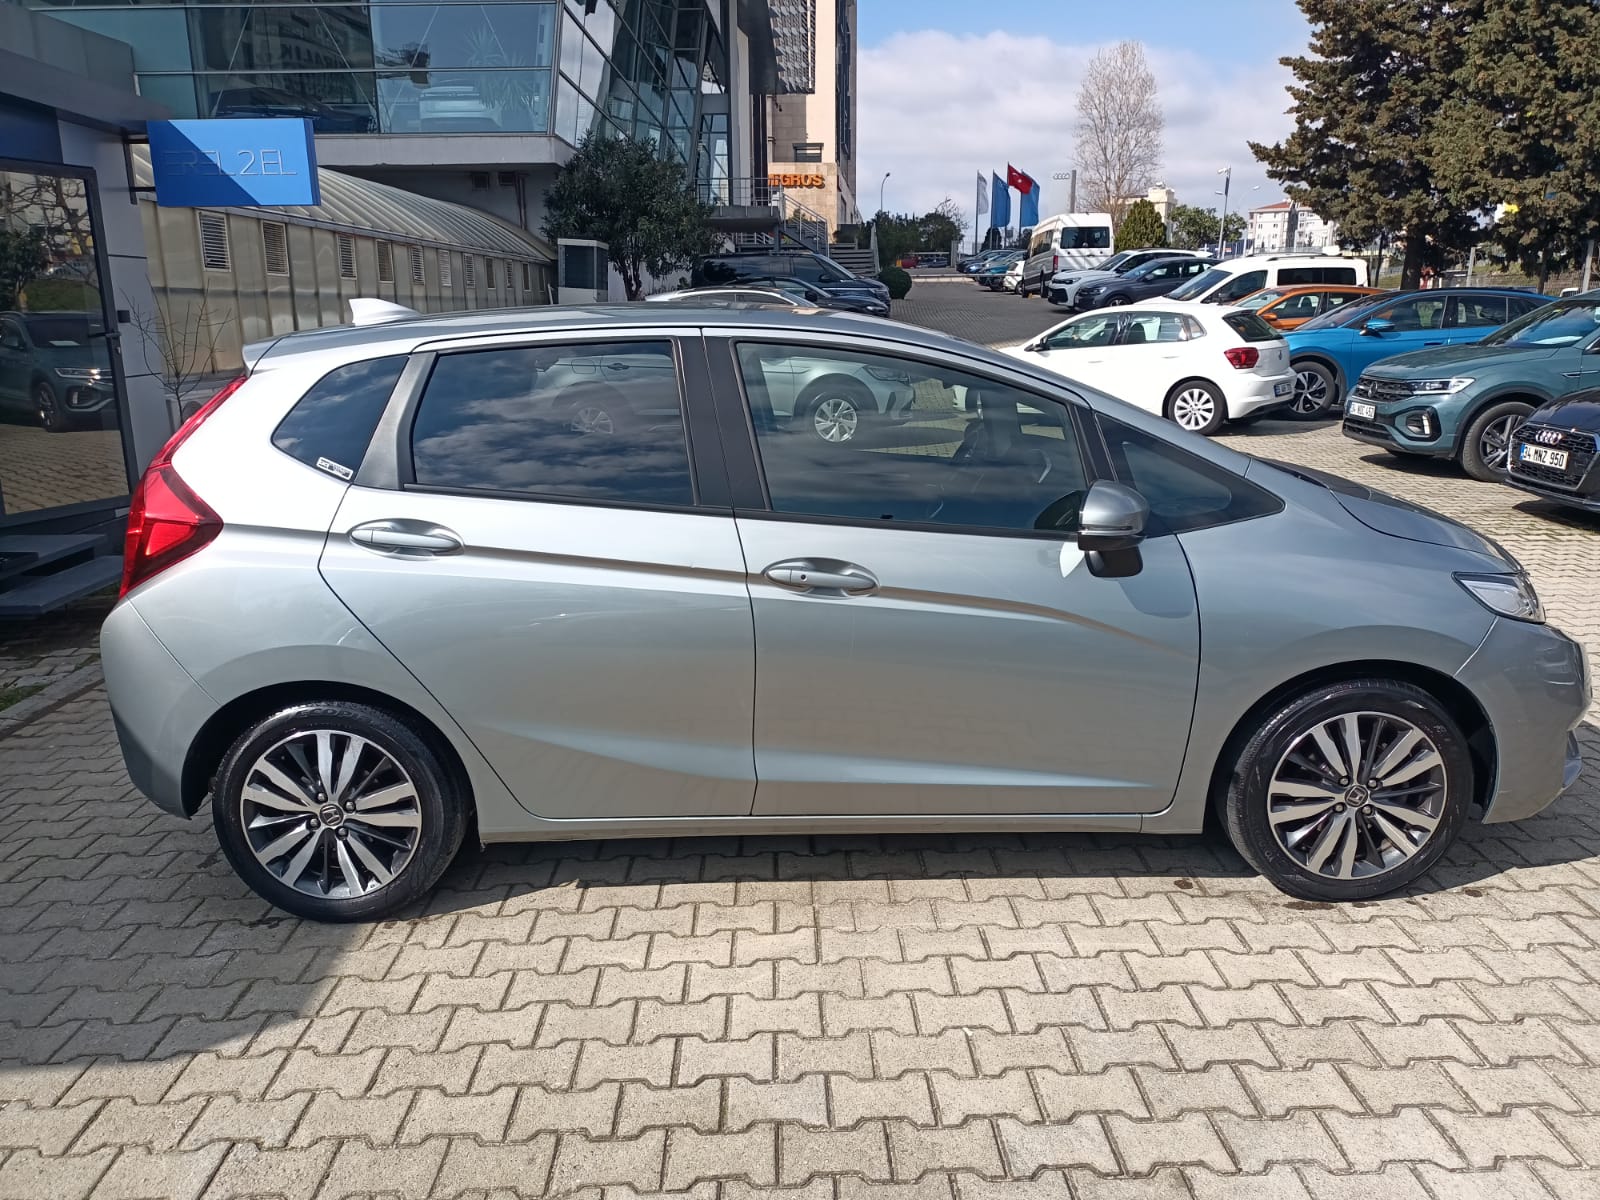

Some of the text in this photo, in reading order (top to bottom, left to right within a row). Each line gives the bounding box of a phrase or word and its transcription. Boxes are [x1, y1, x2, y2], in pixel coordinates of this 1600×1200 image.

[1523, 446, 1565, 467] 34 MNZ 950
